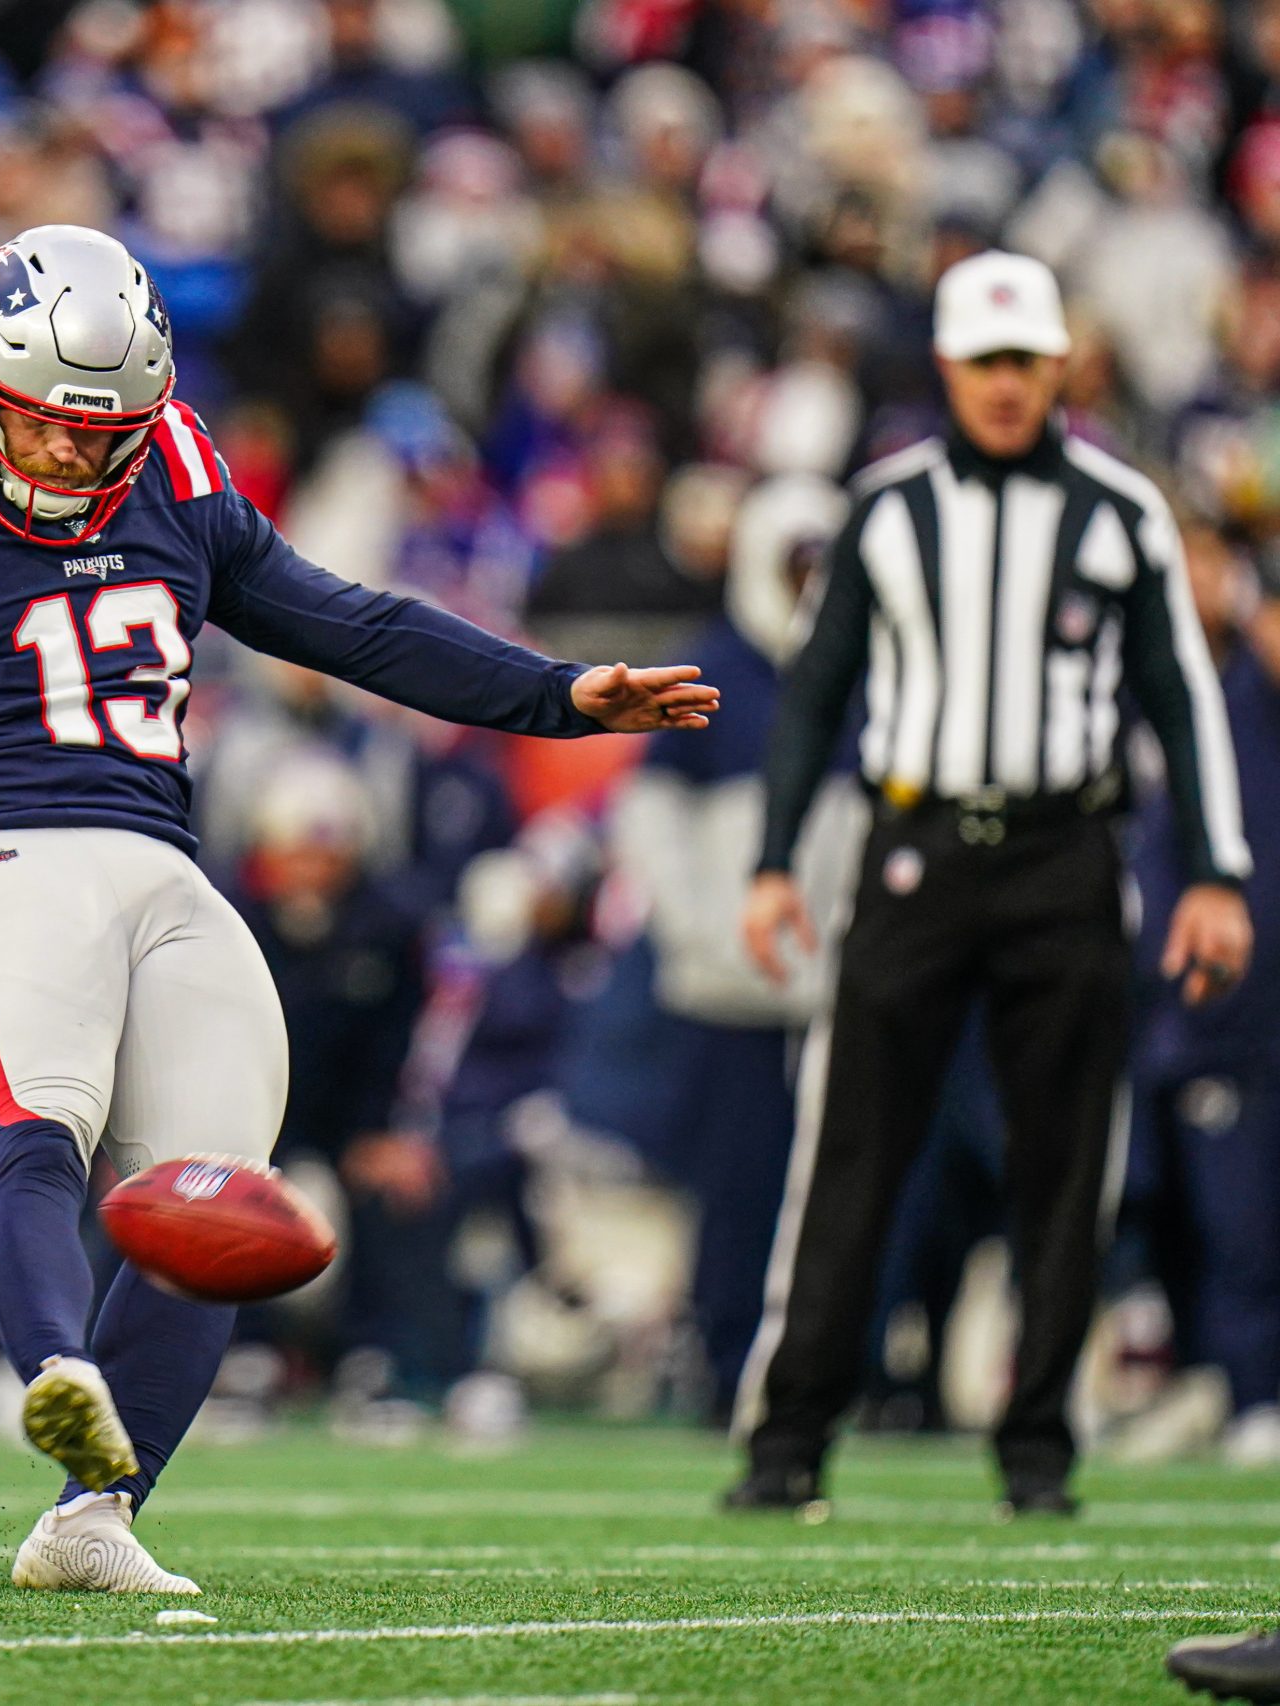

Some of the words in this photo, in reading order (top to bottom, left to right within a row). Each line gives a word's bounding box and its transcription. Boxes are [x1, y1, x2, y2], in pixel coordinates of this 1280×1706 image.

[62, 392, 114, 411] PATRIOTS
[62, 554, 125, 578] PATRIOTS
[13, 580, 192, 762] 13
